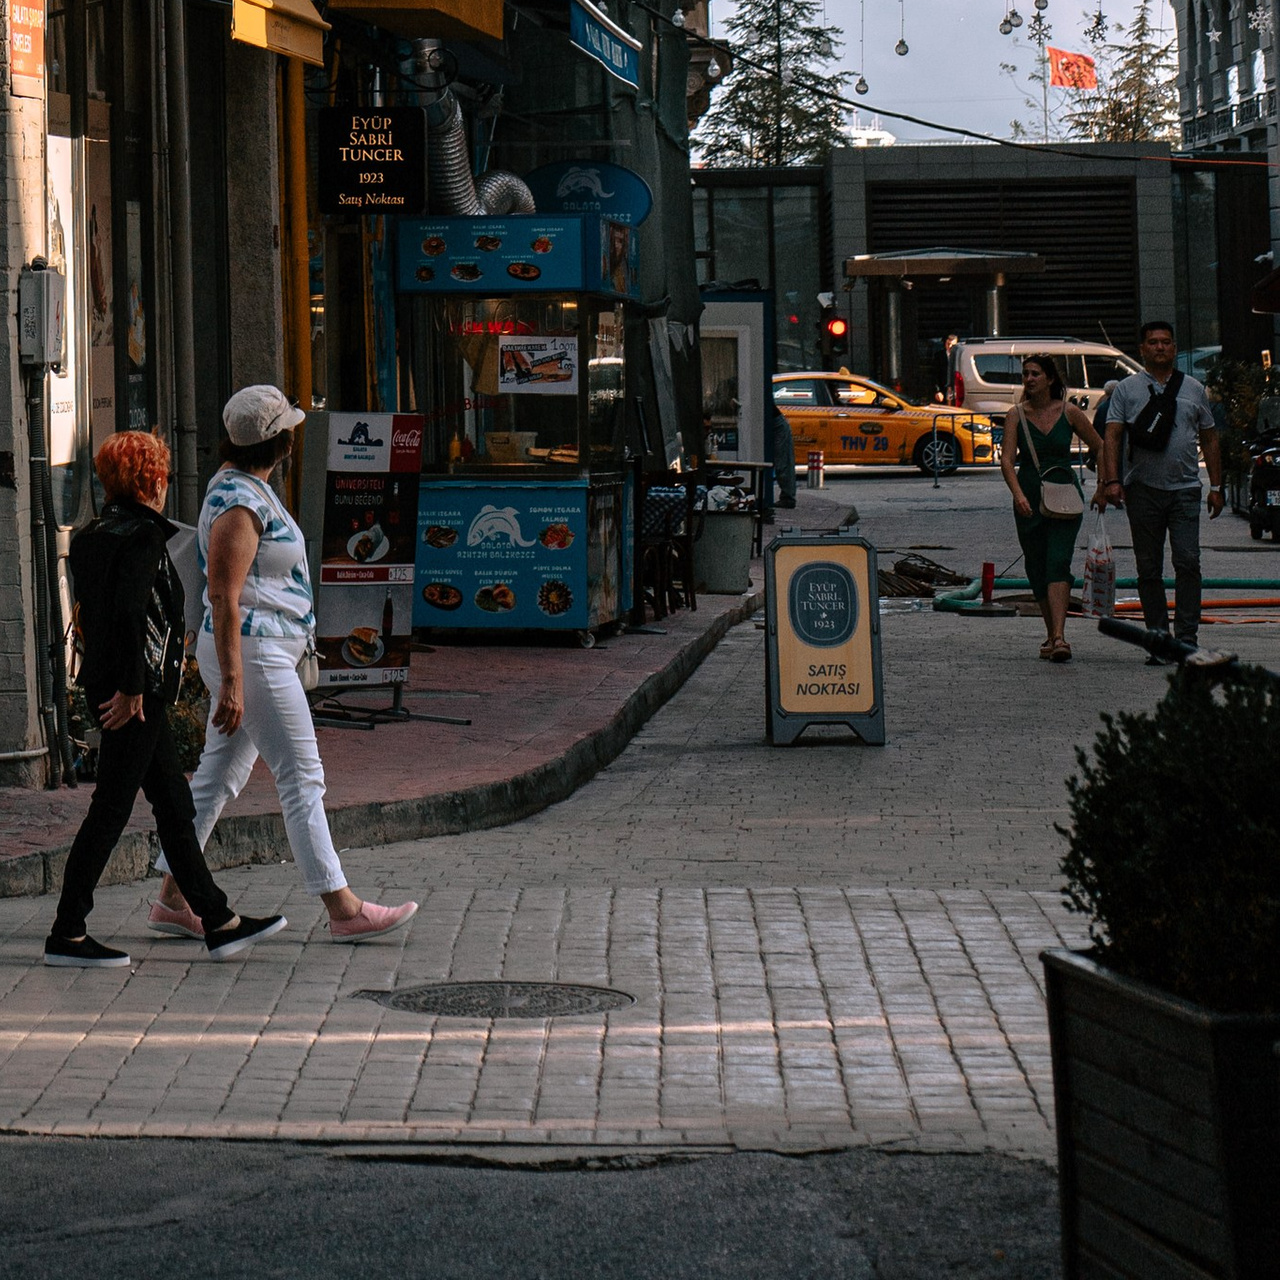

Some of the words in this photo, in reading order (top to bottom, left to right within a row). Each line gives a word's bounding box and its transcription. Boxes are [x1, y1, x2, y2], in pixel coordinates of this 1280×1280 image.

[352, 115, 392, 130] EYÜP
[349, 131, 393, 146] SABRİ
[339, 147, 405, 161] TUNCER
[359, 172, 384, 184] 1923
[338, 193, 362, 208] Satış
[365, 193, 405, 205] Noktası
[392, 429, 423, 447] Coca-Cola
[840, 436, 867, 451] THV
[873, 436, 889, 451] 29
[809, 582, 837, 592] EYÜP
[800, 601, 846, 611] TUNCER
[814, 620, 835, 629] 1923
[808, 663, 847, 680] SATIŞ
[796, 682, 860, 696] NOKTASI
